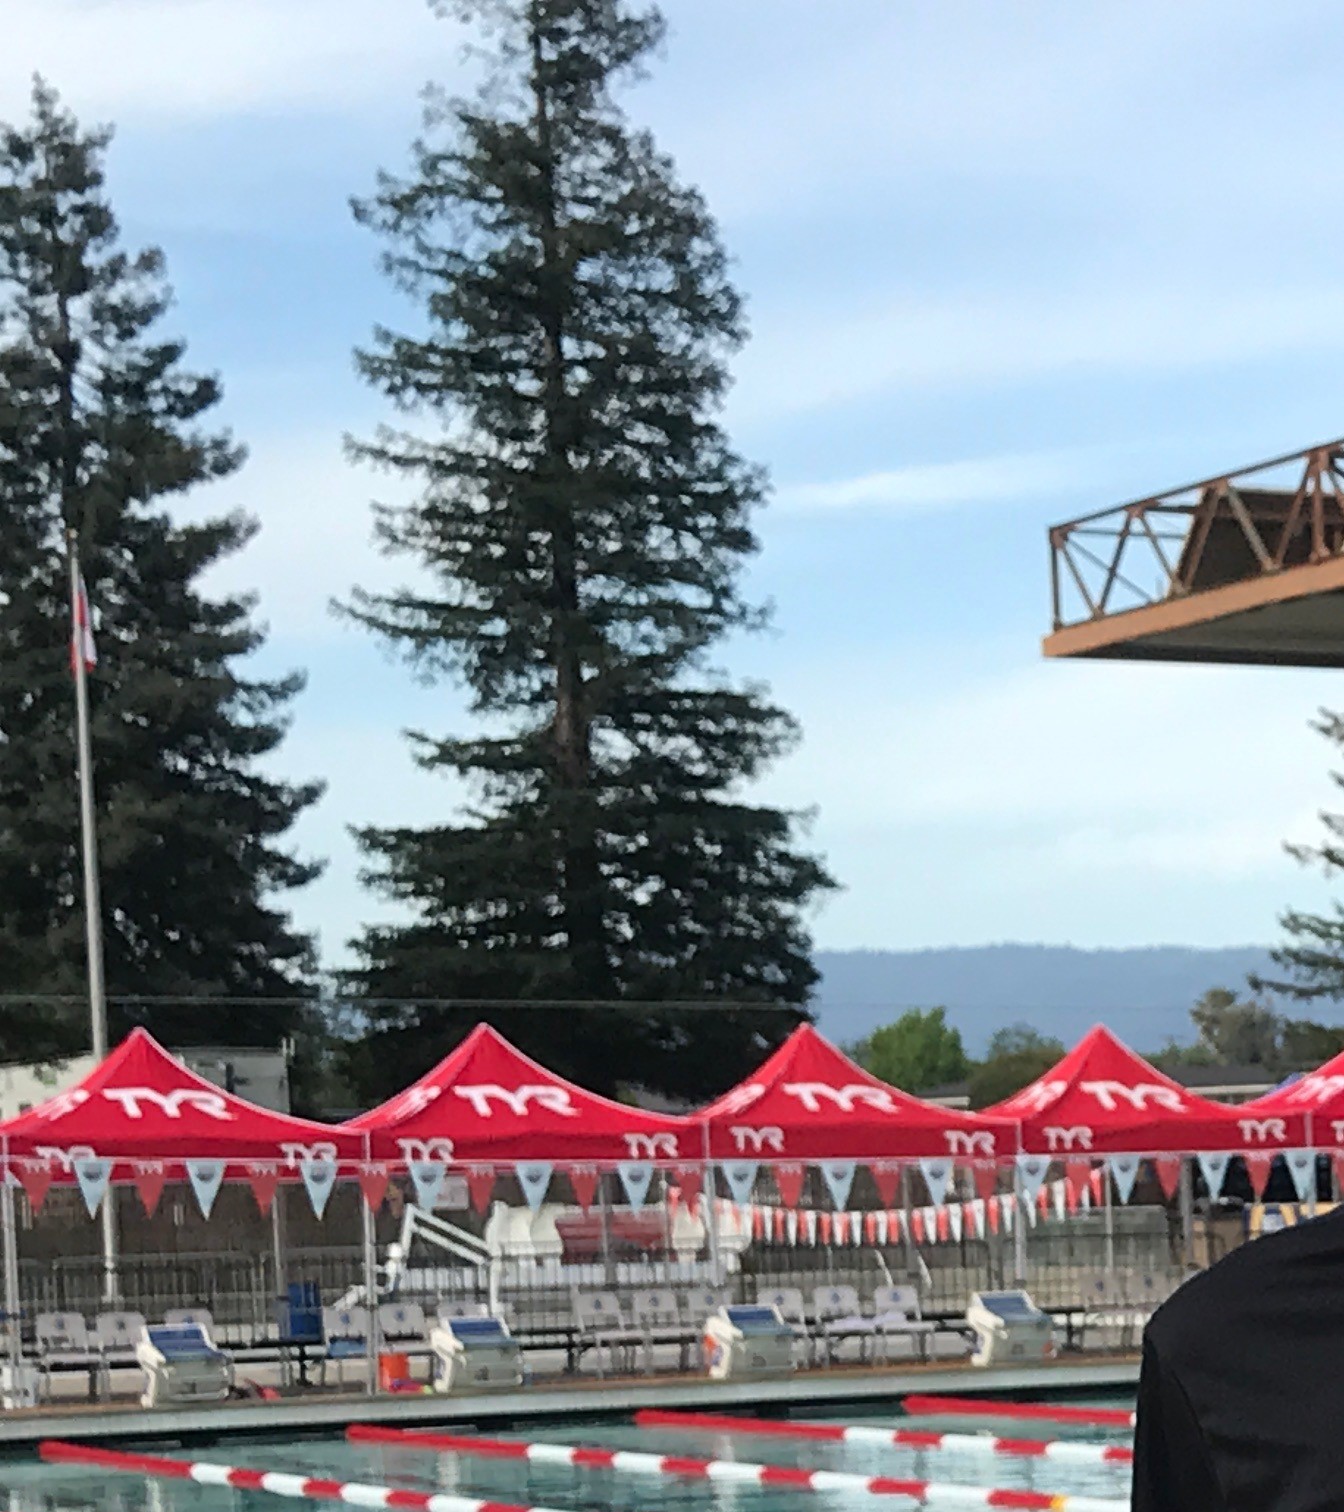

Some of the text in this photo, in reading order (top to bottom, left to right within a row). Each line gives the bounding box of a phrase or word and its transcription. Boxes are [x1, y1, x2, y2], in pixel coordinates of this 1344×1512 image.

[102, 1086, 237, 1121] TYR
[453, 1084, 581, 1117] TYR
[781, 1082, 900, 1114] TYR
[1078, 1080, 1189, 1113] TYR
[728, 1126, 785, 1152] TYR
[943, 1129, 996, 1155] TYR
[1042, 1126, 1094, 1150] TYR
[1237, 1118, 1288, 1143] TYR
[623, 1132, 679, 1159] TYR
